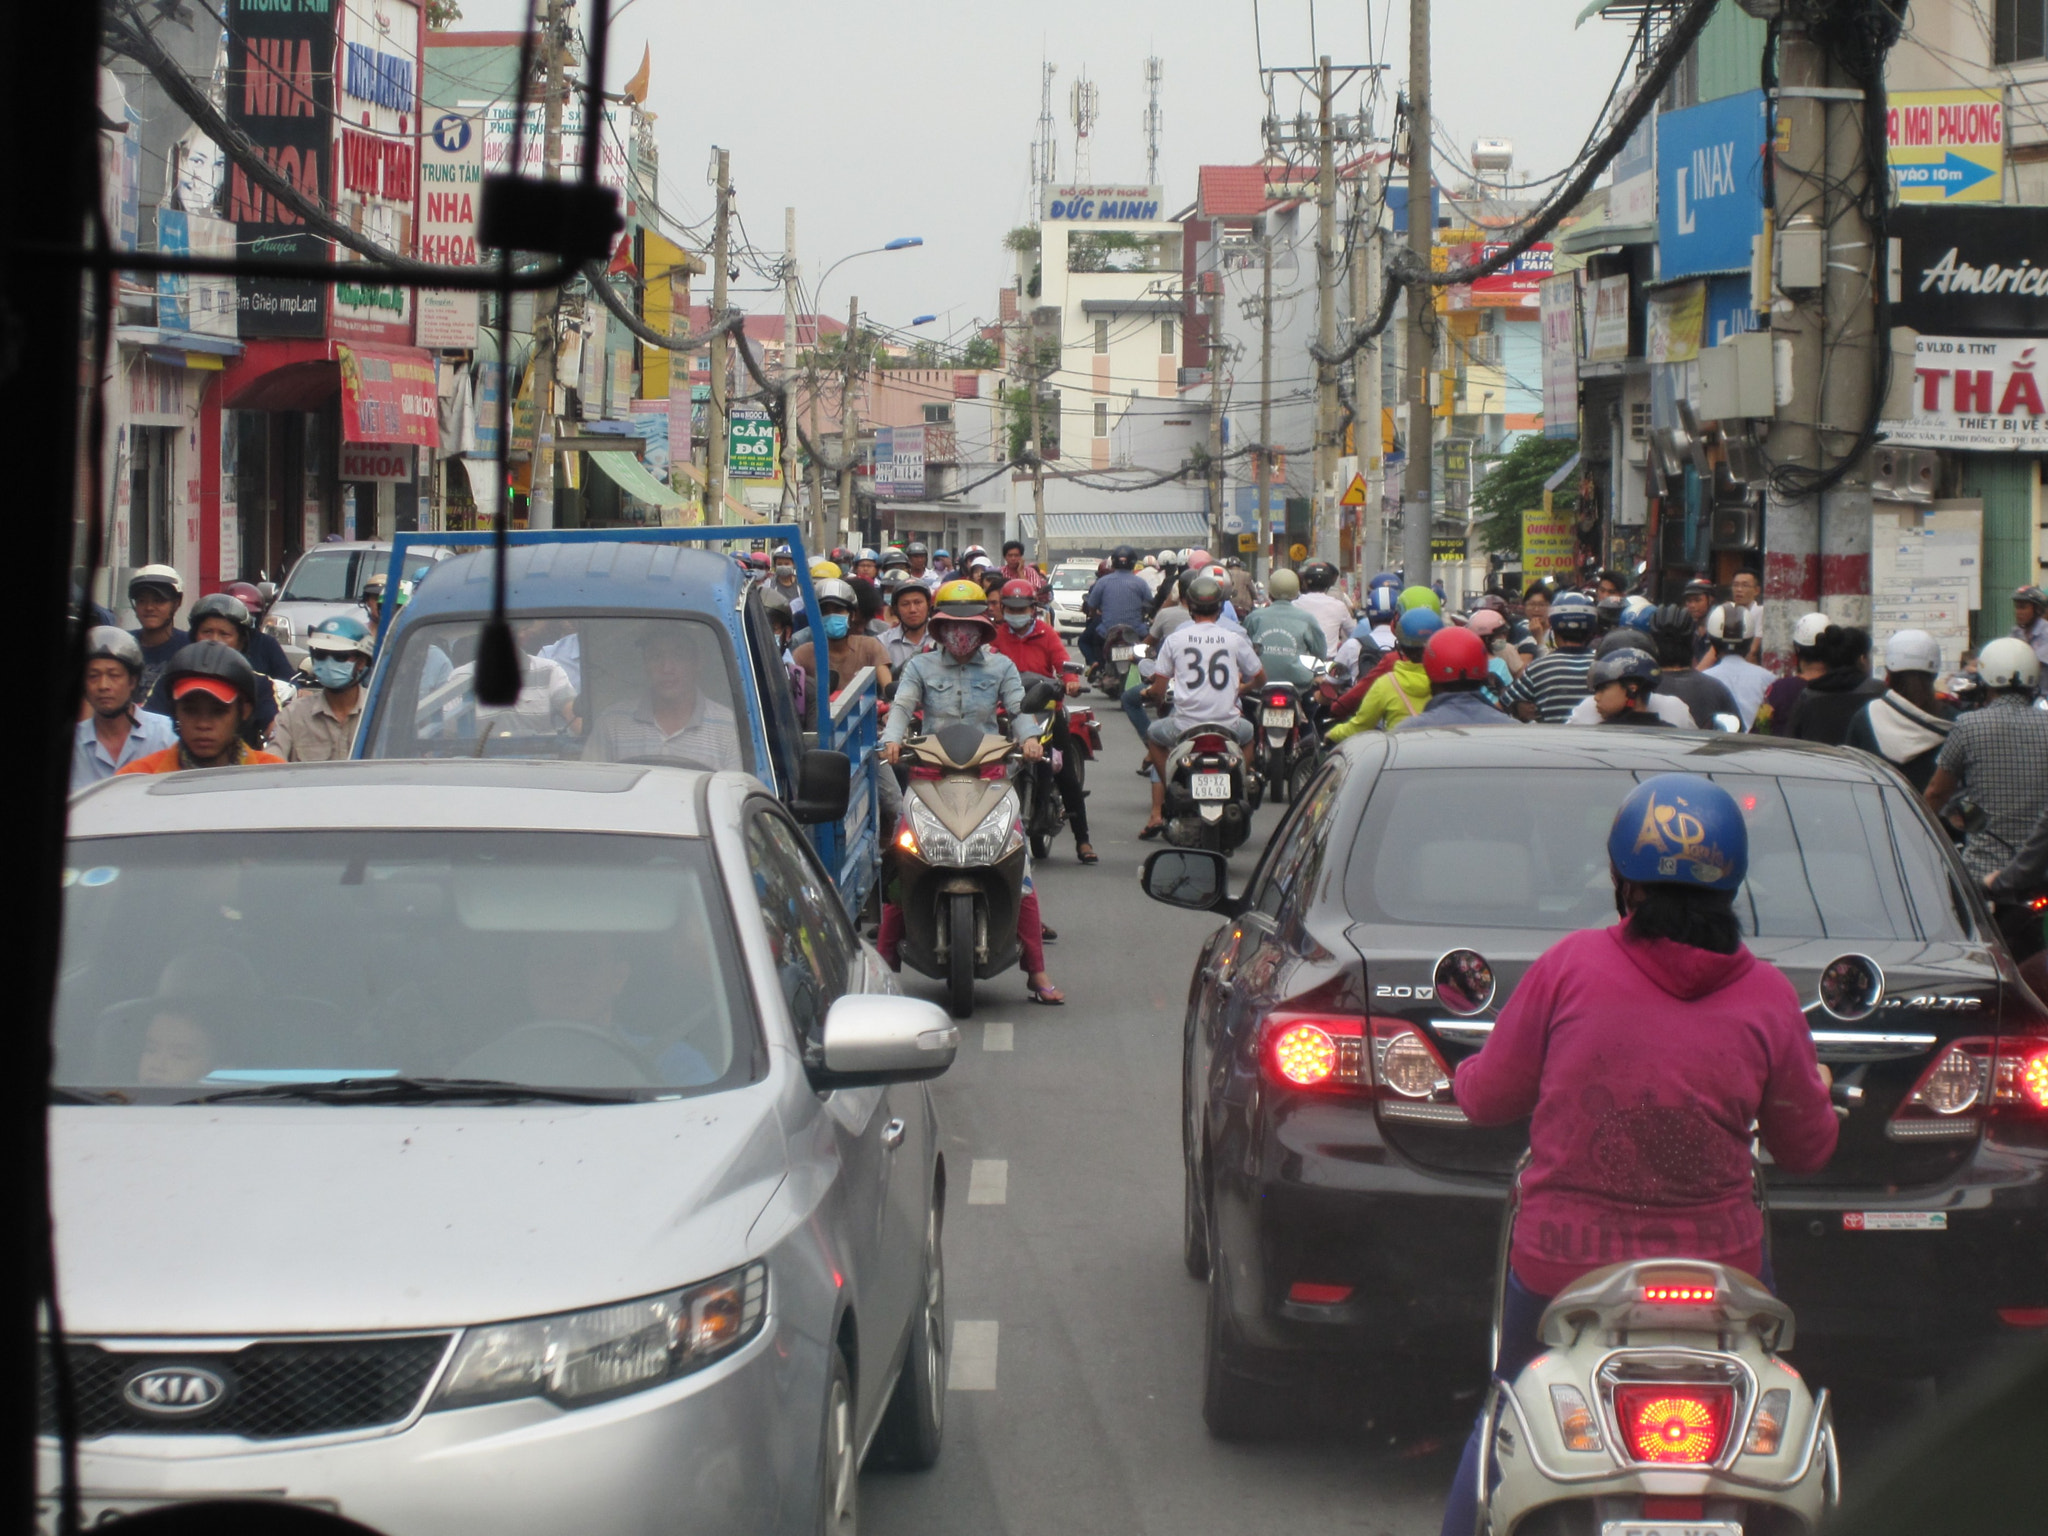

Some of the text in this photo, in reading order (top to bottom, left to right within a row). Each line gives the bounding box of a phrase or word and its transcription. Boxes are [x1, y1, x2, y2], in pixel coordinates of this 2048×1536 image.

[244, 37, 314, 117] NHA
[1904, 106, 1933, 146] MAI
[422, 160, 480, 183] TRUNG TÂM
[1692, 141, 1735, 201] INAX
[1896, 167, 1963, 182] VÀO 10m
[427, 192, 473, 223] NHA
[1050, 195, 1158, 219] ĐỨC MINH
[422, 234, 477, 266] KHOA
[1927, 342, 1954, 354] VLXD
[1969, 343, 1997, 354] TTNT
[1915, 346, 2048, 415] THẮ
[732, 421, 773, 438] CẦM
[735, 439, 768, 455] ĐỒ
[344, 457, 407, 478] KHOA
[1184, 647, 1230, 691] 36
[1197, 776, 1225, 786] 59-X2
[1376, 985, 1413, 998] 2.0
[141, 1376, 208, 1402] KIA
